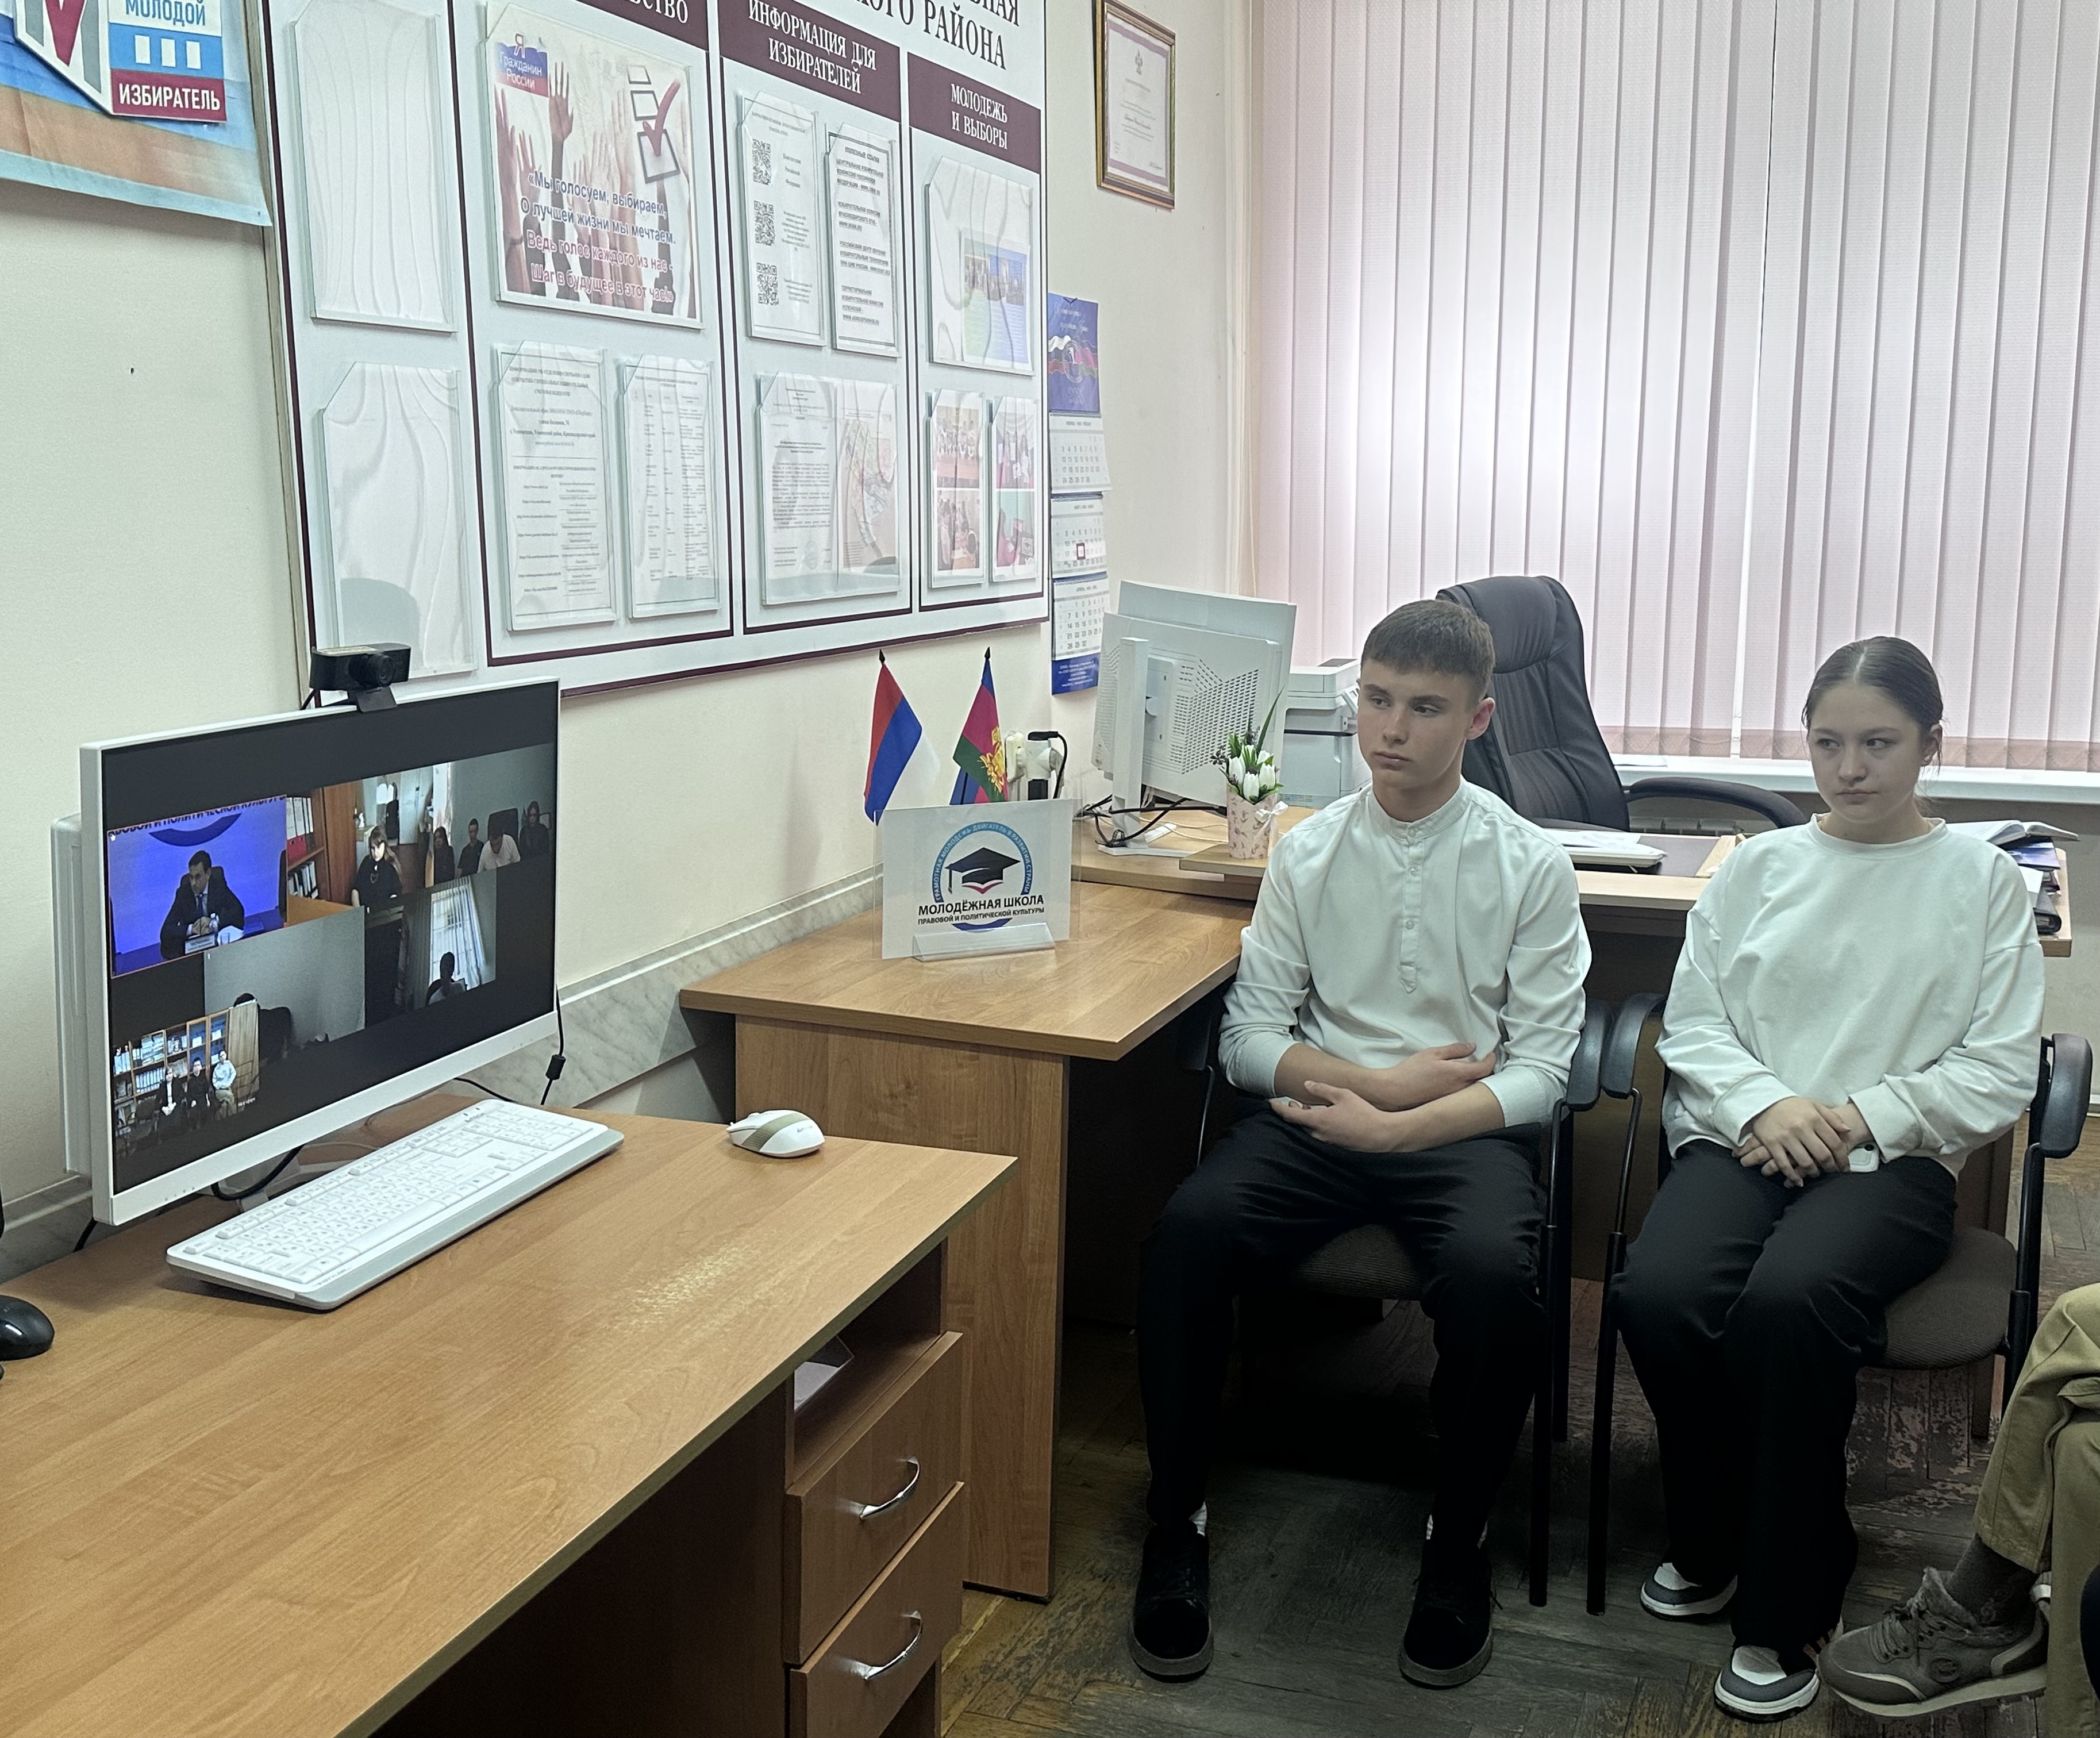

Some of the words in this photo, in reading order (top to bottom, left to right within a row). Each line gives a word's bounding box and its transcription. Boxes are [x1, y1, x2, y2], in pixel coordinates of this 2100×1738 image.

[125, 0, 206, 27] МОЛОДОЙ
[749, 0, 847, 58] ИНФОРМАЦИЯ
[851, 41, 876, 70] ДЛЯ
[923, 0, 1006, 70] РАЙОНА
[499, 51, 543, 76] Гражданин
[506, 69, 536, 90] России
[768, 37, 861, 94] ИЗБИРАТЕЛЕЙ
[118, 83, 221, 111] ИЗБИРАТЕЛЬ
[951, 83, 1008, 124] МОЛОДЕЖЬ
[952, 111, 960, 131] И
[963, 115, 1008, 149] ВЫБОРЫ
[554, 179, 609, 205] голосуем,
[613, 193, 667, 220] выбираем,
[521, 198, 529, 214] О
[533, 202, 574, 224] лучшей
[577, 213, 609, 231] жизни
[612, 220, 628, 234] мы
[631, 225, 676, 244] мечтаем.
[526, 230, 556, 253] Ведь
[558, 240, 590, 258] голос
[592, 247, 634, 267] каждого
[637, 256, 648, 268] из
[651, 257, 667, 272] нас
[531, 263, 555, 284] Шаг
[556, 274, 564, 285] в
[566, 271, 613, 294] будущее
[616, 282, 623, 294] в
[625, 283, 647, 298] этот
[918, 899, 1001, 916] МОЛОДЁЖНАЯ
[1003, 894, 1044, 908] ШКОЛА
[918, 914, 953, 925] ПРАВОВОЙ
[960, 910, 1011, 921] ПОЛИТИЧЕСКОЙ
[1013, 907, 1045, 917] КУЛЬТУРЫ
